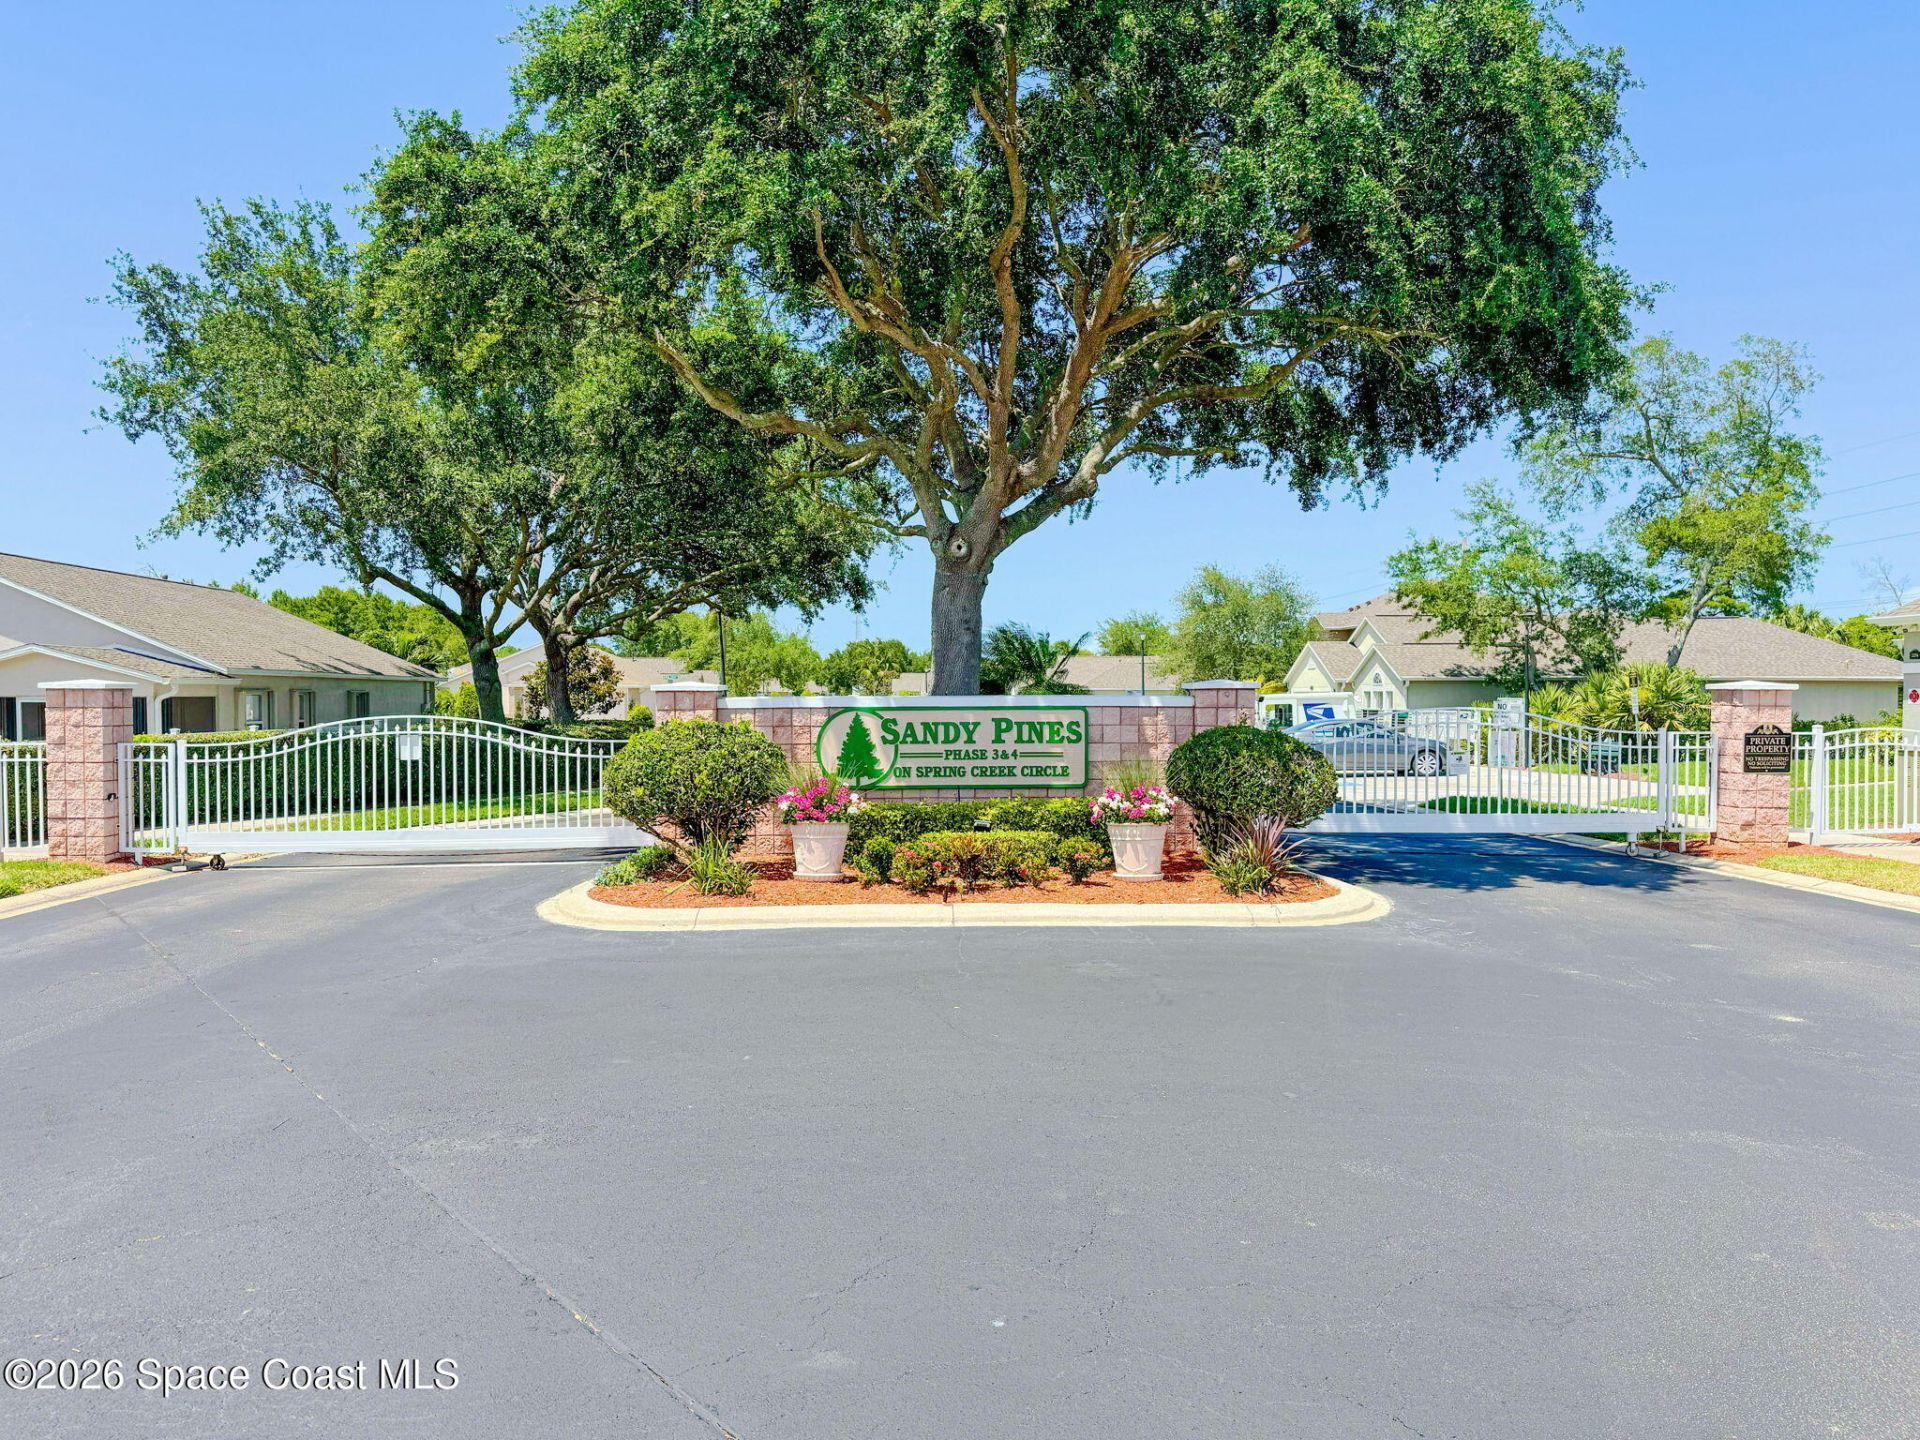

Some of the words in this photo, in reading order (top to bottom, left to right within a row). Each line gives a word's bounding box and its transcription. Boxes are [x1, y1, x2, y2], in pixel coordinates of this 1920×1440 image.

[880, 717, 980, 745] SANDY
[991, 717, 1083, 745] PINES
[1750, 737, 1786, 745] PRIVATE
[943, 749, 988, 761] PHASE
[991, 749, 1018, 760] 3&4
[1745, 745, 1790, 753] PROPERTY
[894, 766, 912, 778] ON
[916, 766, 967, 778] SPRING
[970, 765, 1017, 778] CREEK
[1020, 765, 1070, 777] CIRCLE
